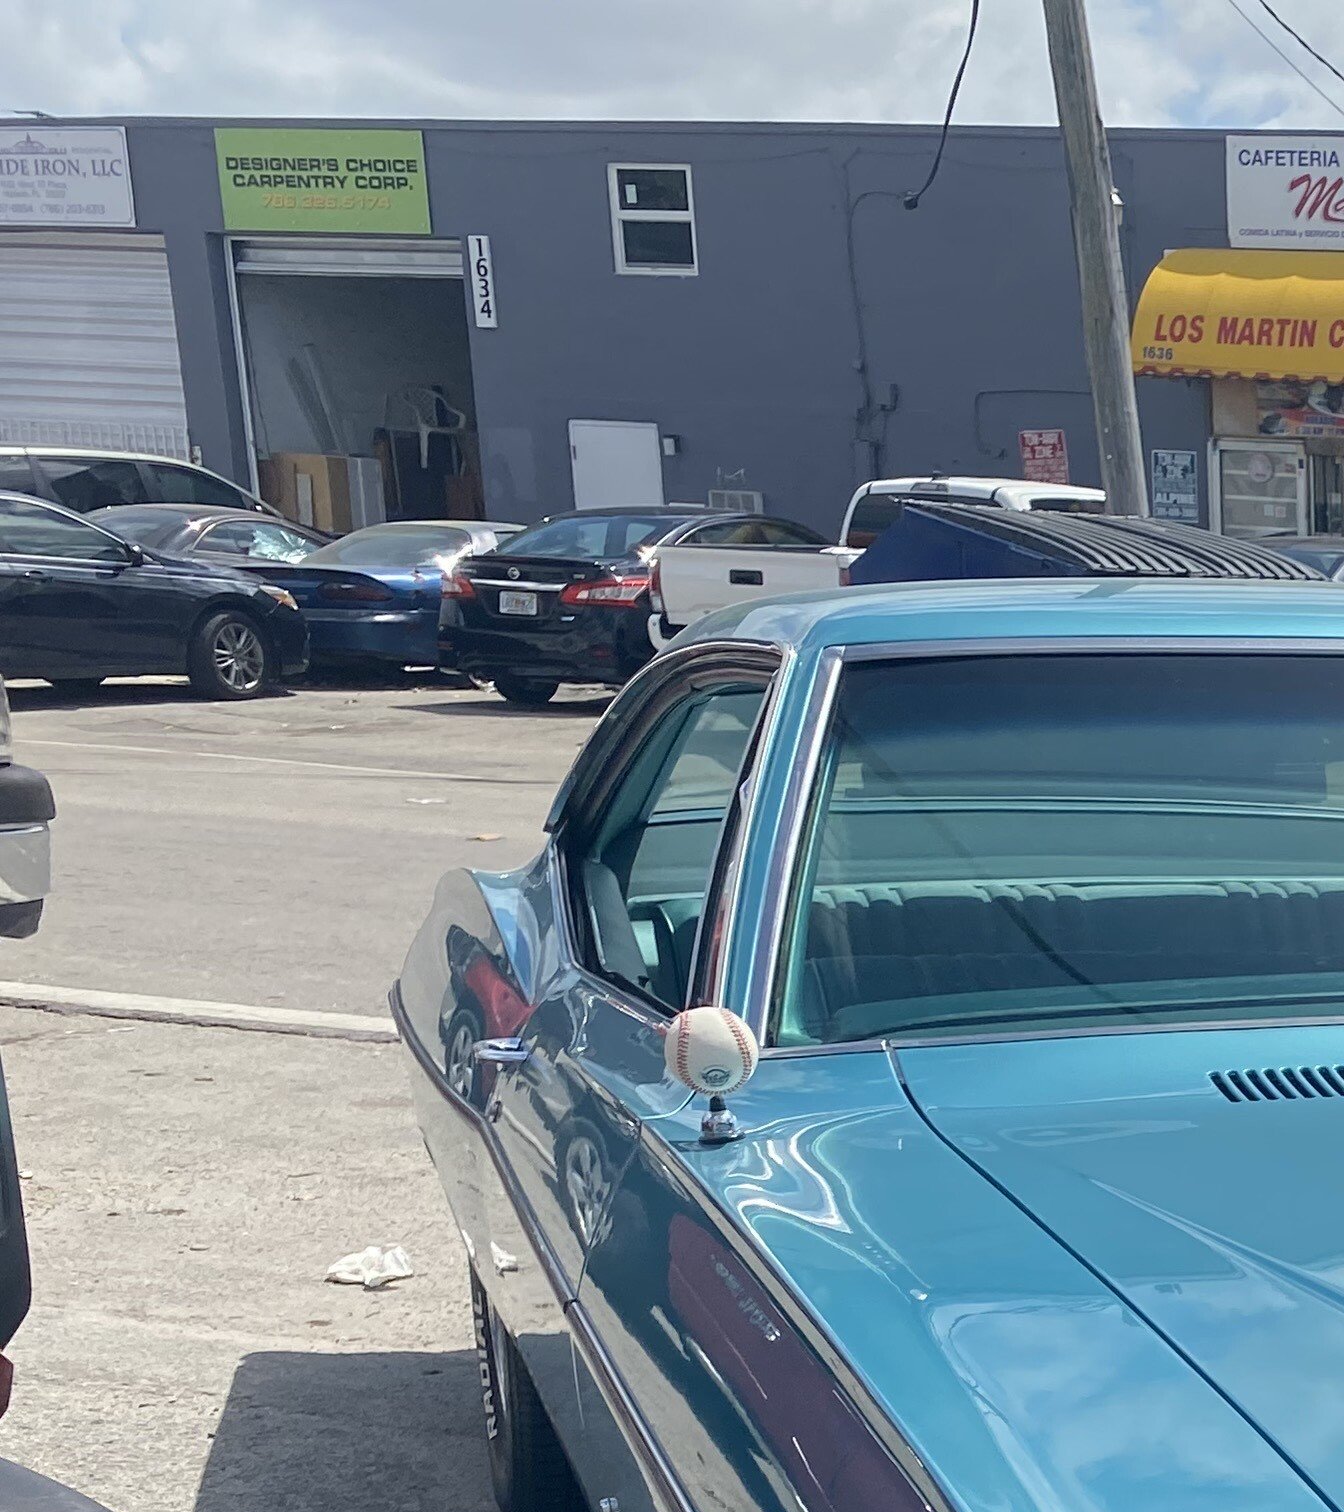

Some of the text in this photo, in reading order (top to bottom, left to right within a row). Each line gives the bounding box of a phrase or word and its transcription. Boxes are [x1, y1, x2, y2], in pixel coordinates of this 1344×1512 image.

[225, 157, 418, 173] DESIGNER'S CHOICE
[1238, 149, 1341, 168] CAFETERIA
[34, 159, 87, 178] IRON,
[91, 159, 122, 176] LLC
[232, 174, 414, 190] CARPENTRY CORP.
[475, 238, 492, 318] 1634
[1154, 313, 1205, 344] LOS
[1216, 316, 1318, 347] MARTIN
[1143, 346, 1174, 361] 1636
